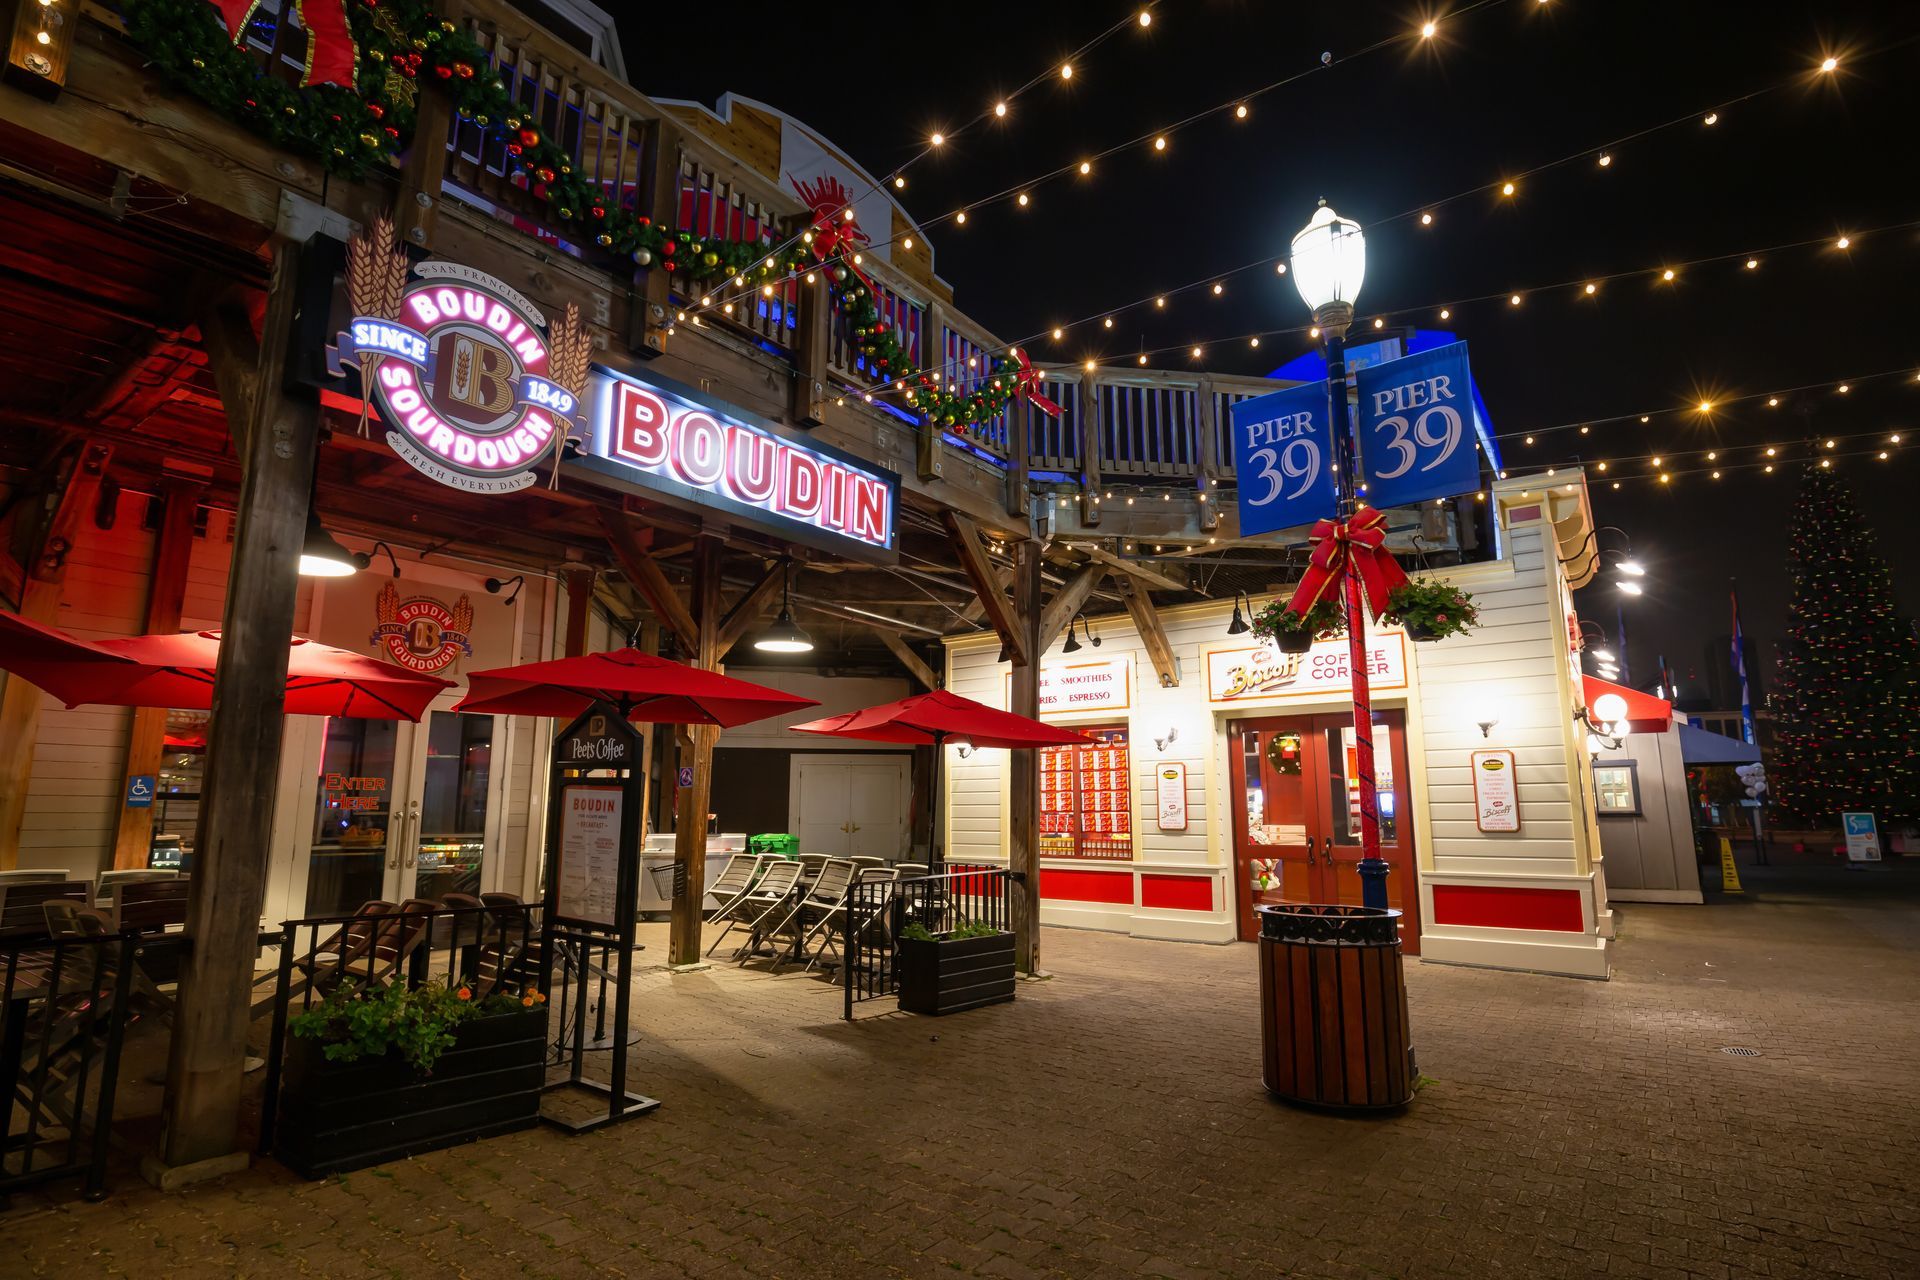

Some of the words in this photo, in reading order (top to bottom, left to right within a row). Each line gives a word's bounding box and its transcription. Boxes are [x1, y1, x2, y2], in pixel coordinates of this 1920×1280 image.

[431, 264, 457, 274] SAN
[464, 269, 534, 313] FRANCISCO
[353, 322, 428, 362] SINCE
[410, 290, 546, 364] BOUDIN
[528, 380, 573, 412] 1849
[1372, 375, 1456, 417] PIER
[381, 366, 553, 467] SOURDOUGH
[1246, 411, 1317, 448] PIER
[1374, 405, 1462, 479] 39
[402, 447, 446, 479] FRESH
[451, 475, 493, 491] EVERY
[499, 479, 522, 490] DAY
[611, 380, 890, 543] BOUDIN
[1248, 439, 1321, 506] 39
[381, 625, 407, 634] SINCE
[400, 604, 453, 627] BOUDIN
[446, 632, 465, 642] 1849
[390, 639, 456, 670] SOURDOUGH
[1312, 649, 1387, 667] COFEE
[1060, 673, 1113, 685] SMOOTHIES
[1223, 653, 1305, 697] Biscoff
[1311, 663, 1389, 680] CORER
[1040, 696, 1058, 705] RIES
[1069, 691, 1110, 702] ESPRESSO
[596, 738, 624, 761] Coffee
[325, 773, 386, 791] ENTER
[328, 793, 379, 810] HERE
[573, 798, 615, 812] BOUDIN
[1482, 805, 1512, 818] Biscoff
